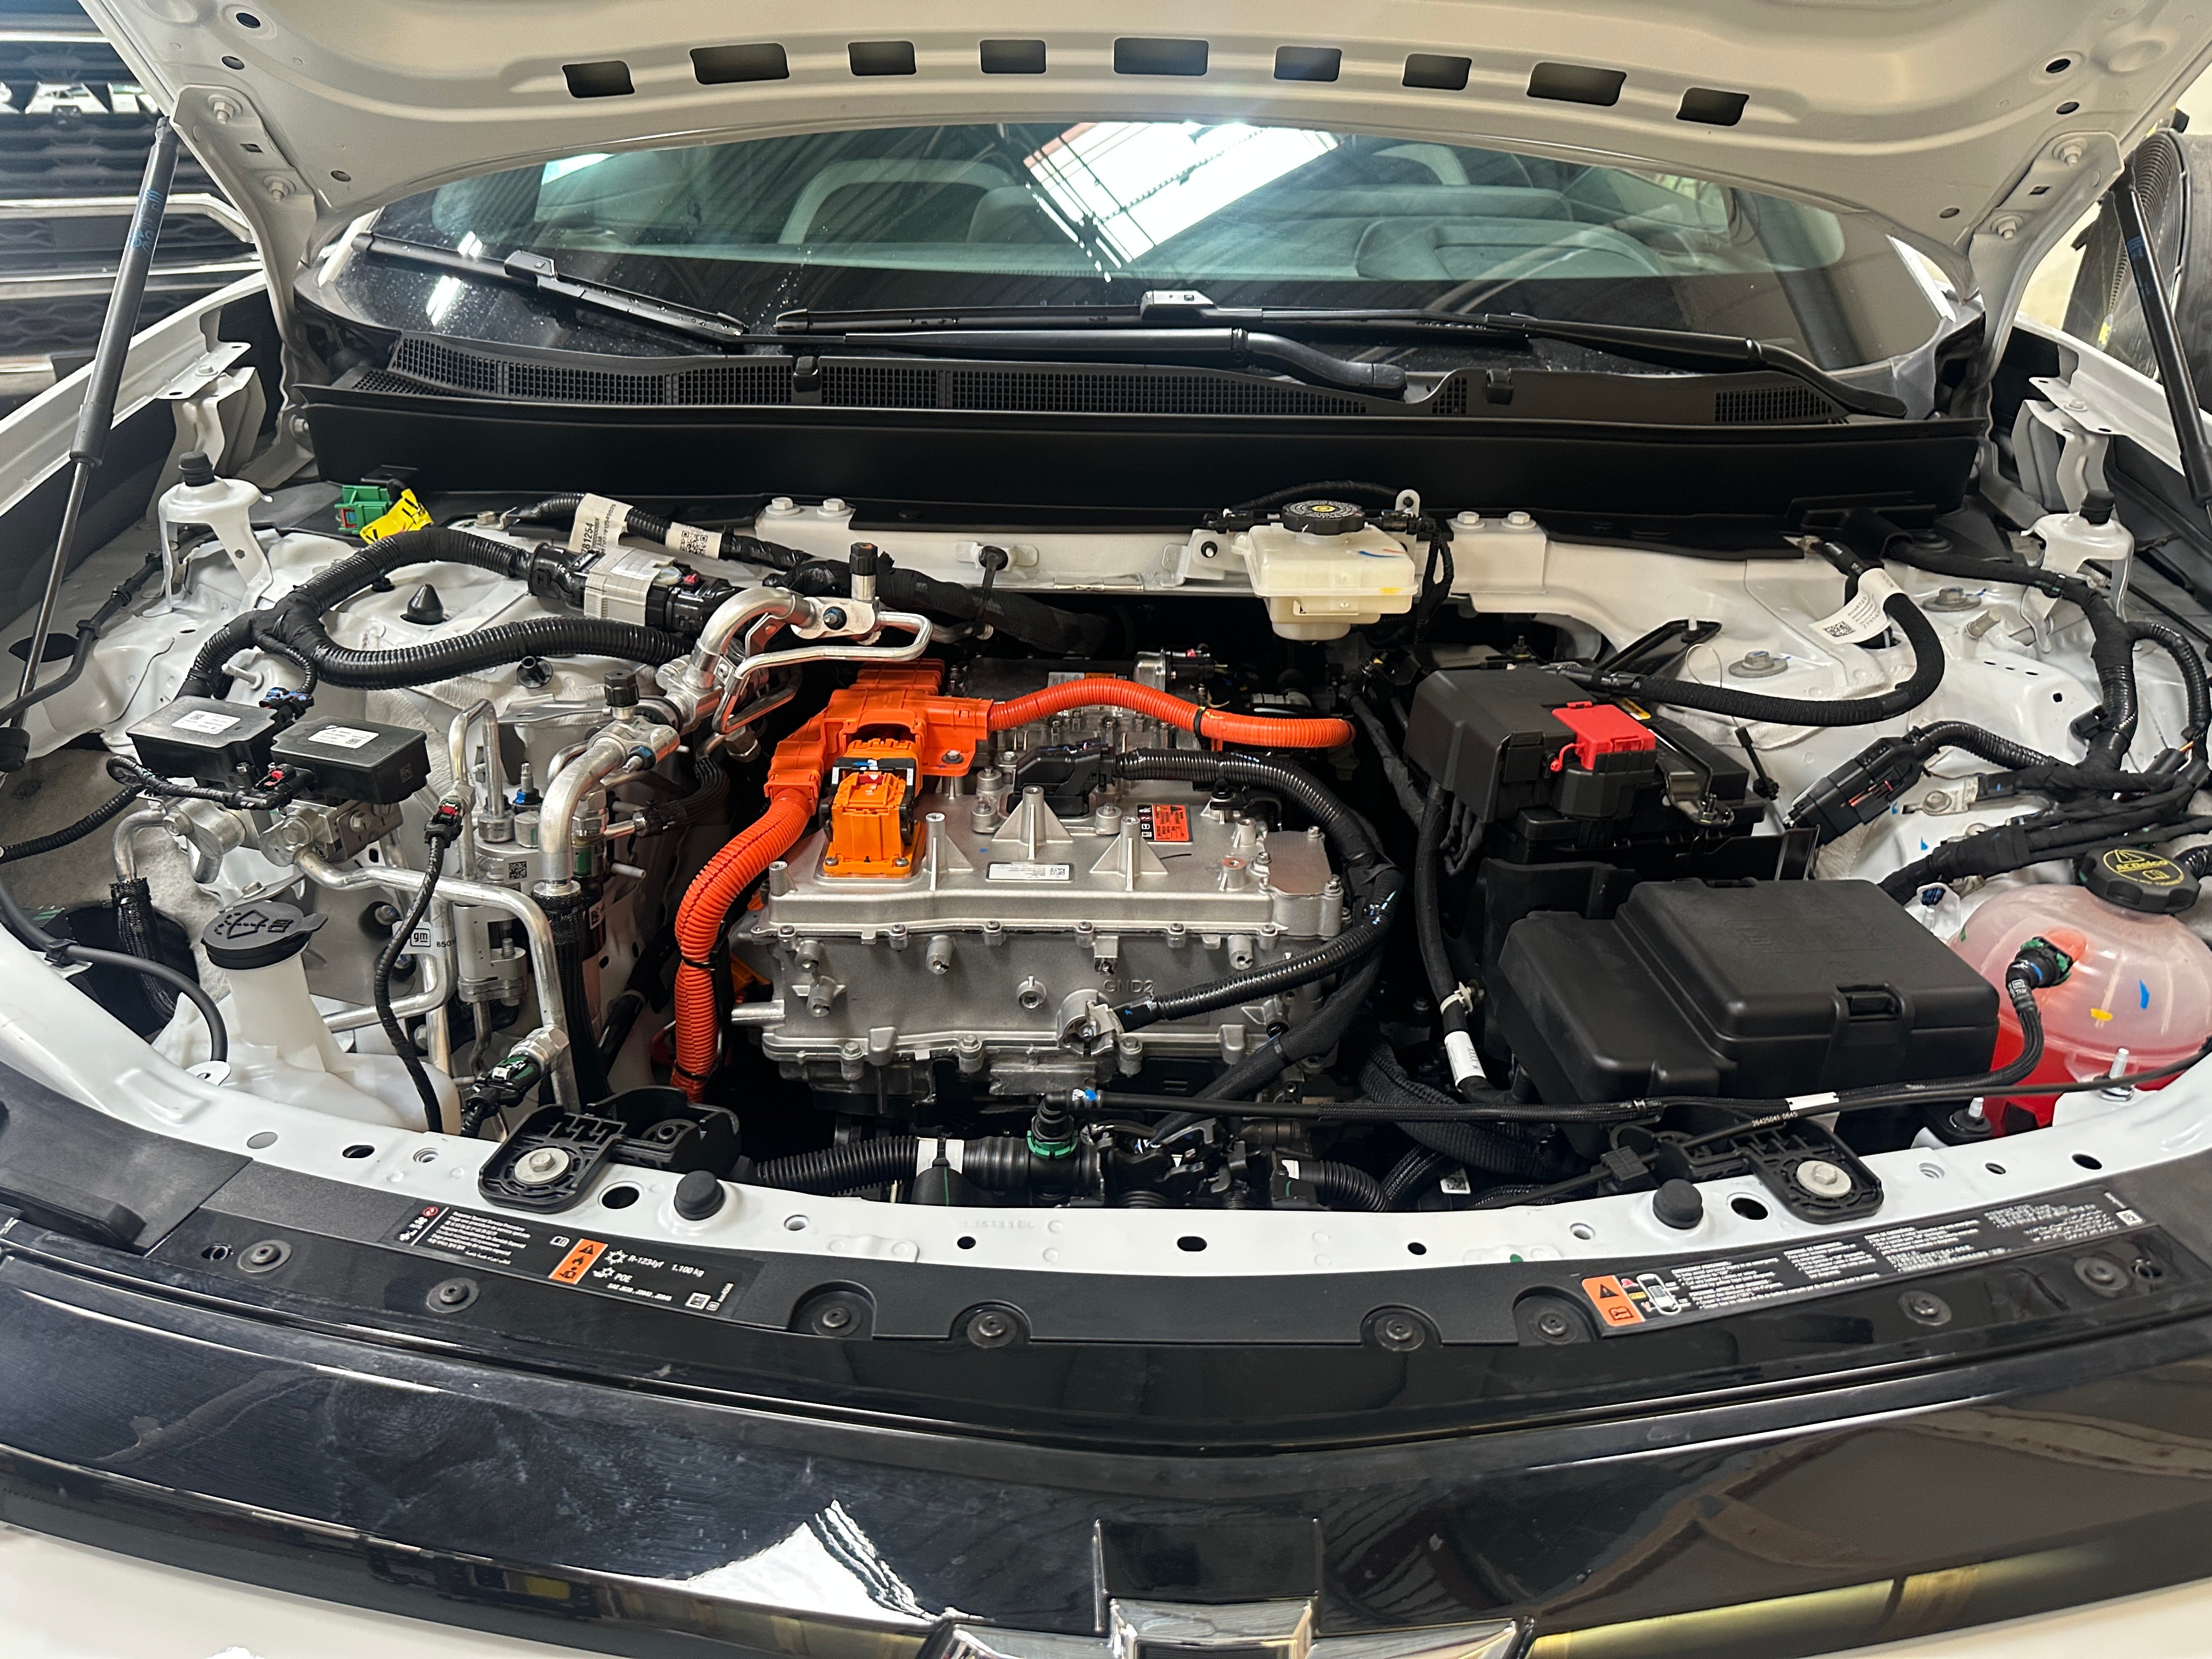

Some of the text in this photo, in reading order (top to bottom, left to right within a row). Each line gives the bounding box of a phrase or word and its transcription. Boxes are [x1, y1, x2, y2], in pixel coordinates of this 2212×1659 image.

[414, 932, 428, 943] gm
[1103, 979, 1154, 994] GND2
[628, 1255, 705, 1277] R-1234yf 1.100 kg
[614, 1272, 634, 1283] POE
